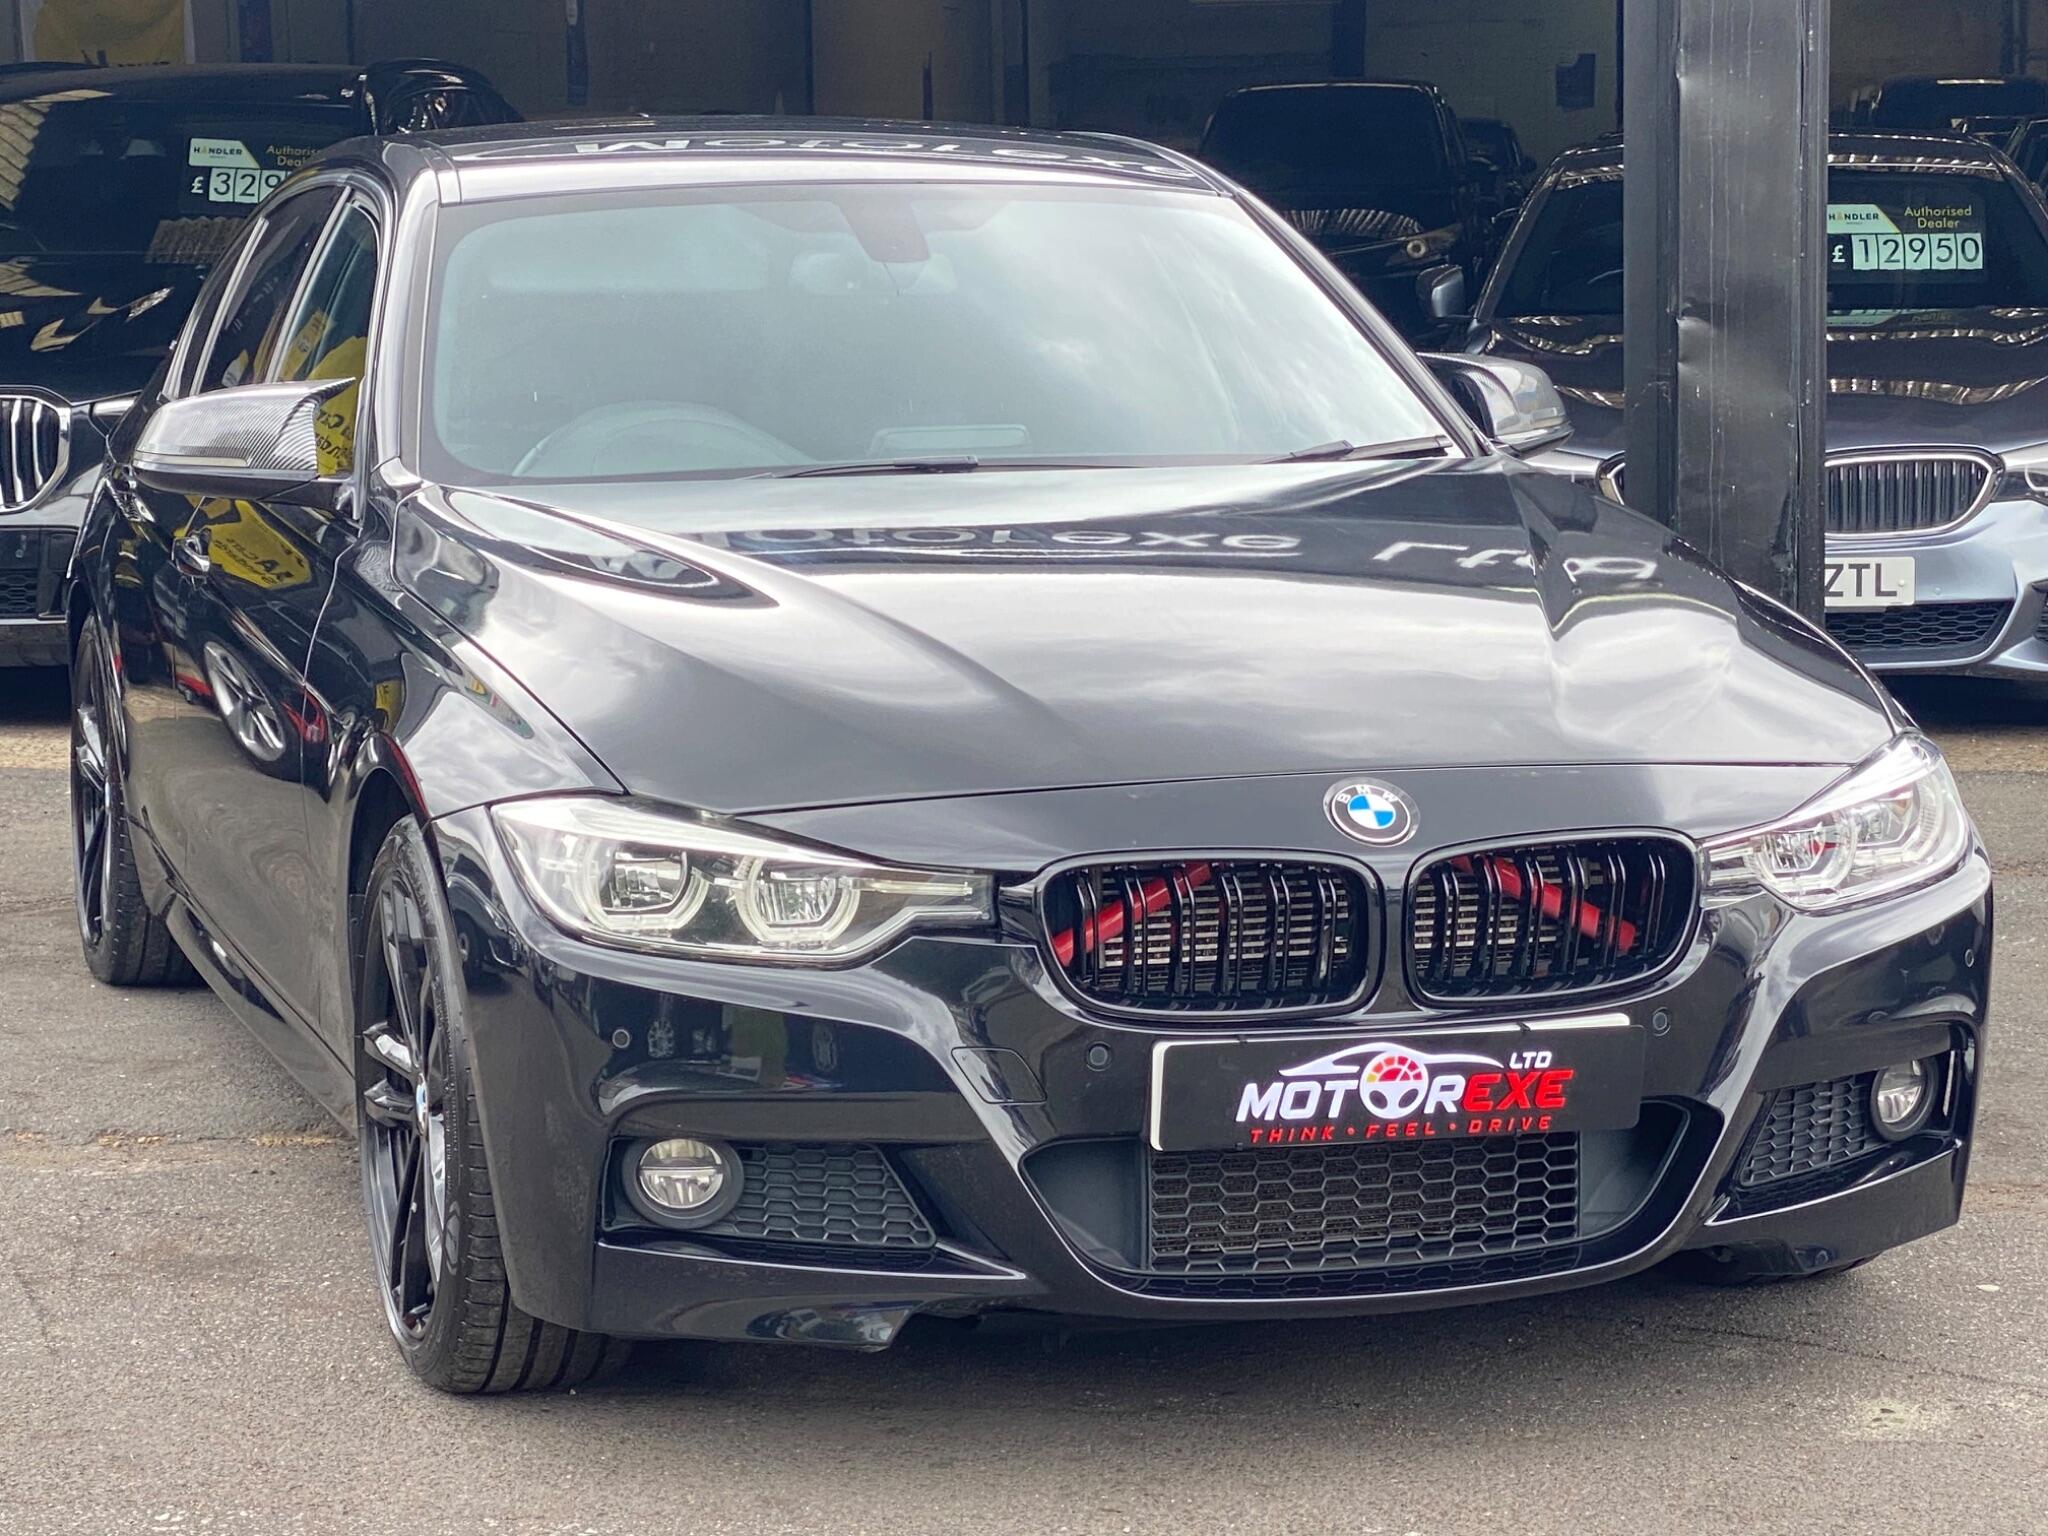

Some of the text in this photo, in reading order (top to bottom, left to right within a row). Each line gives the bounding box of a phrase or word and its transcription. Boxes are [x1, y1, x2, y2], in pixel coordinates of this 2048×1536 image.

[1904, 204, 1972, 217] Authorised
[1917, 217, 1960, 229] Dealer
[1336, 784, 1400, 804] BMW
[1509, 1050, 1553, 1070] LTD
[1250, 1116, 1553, 1144] THINK FEEL DRIVE
